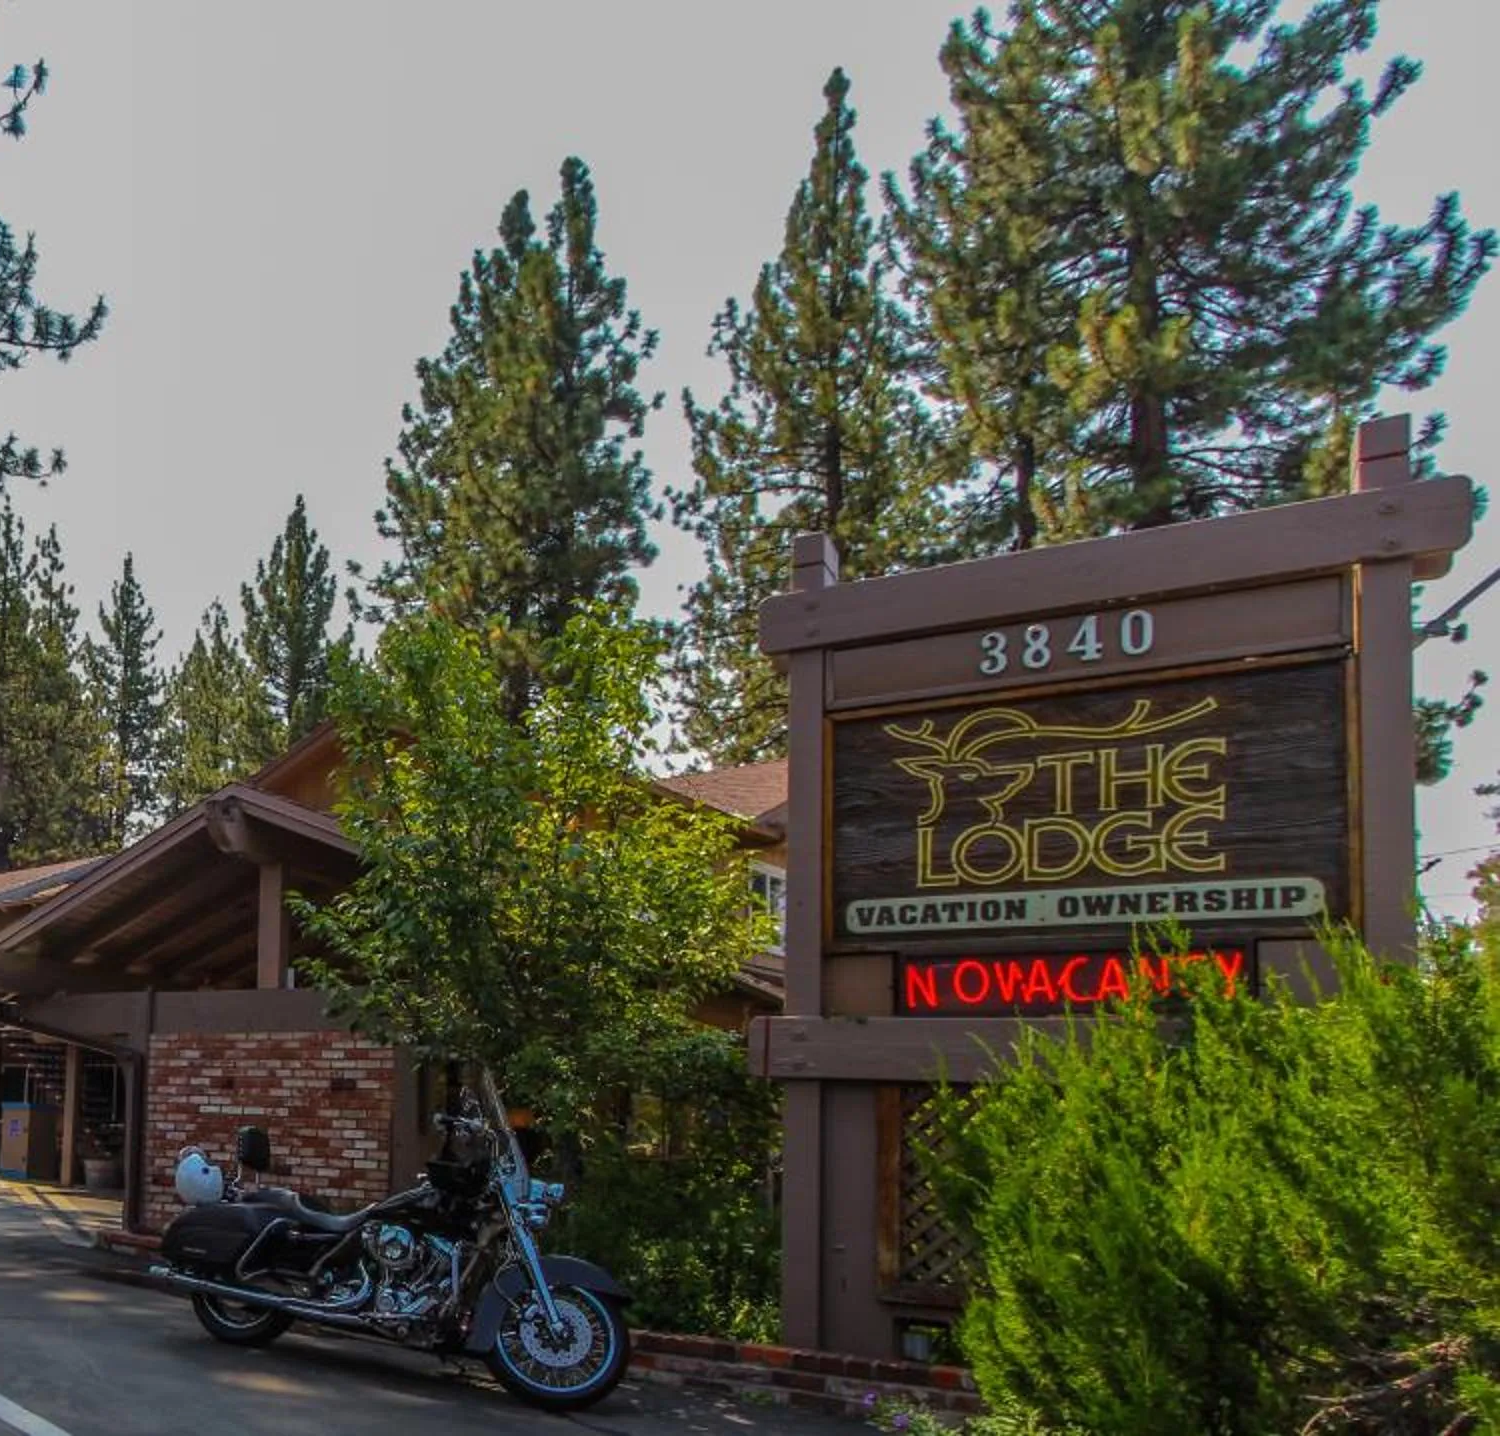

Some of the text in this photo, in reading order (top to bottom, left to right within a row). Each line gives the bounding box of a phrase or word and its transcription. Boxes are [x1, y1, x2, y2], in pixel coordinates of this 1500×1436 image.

[979, 609, 1154, 676] 3840
[1036, 737, 1228, 816] THE
[915, 803, 1227, 888] LODGE
[856, 885, 1308, 928] VACATION OWNERSHIP
[904, 957, 991, 1010] NO
